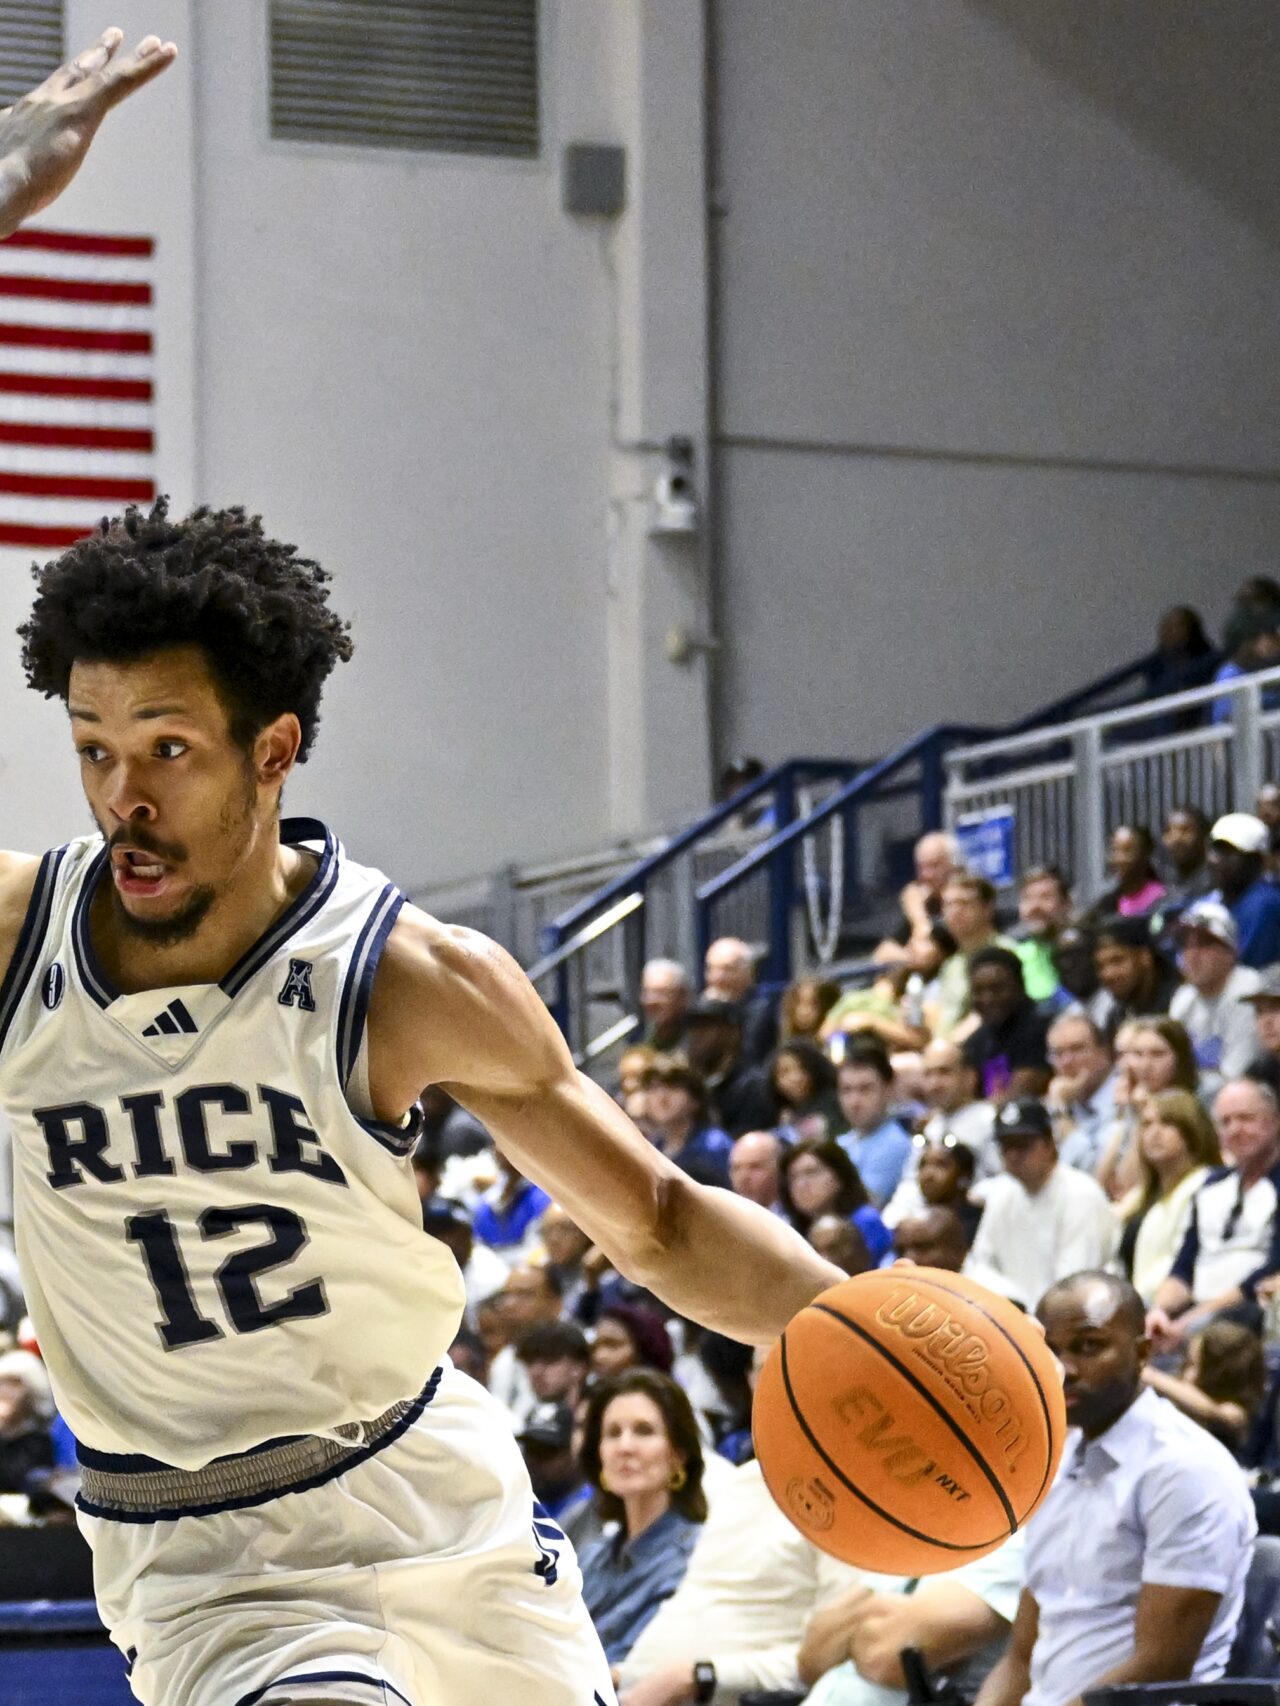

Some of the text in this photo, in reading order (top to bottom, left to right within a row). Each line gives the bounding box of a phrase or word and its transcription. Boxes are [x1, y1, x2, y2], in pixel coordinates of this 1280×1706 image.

[33, 1082, 350, 1190] RICE
[124, 1202, 332, 1353] 12
[935, 1473, 972, 1502] NXT
